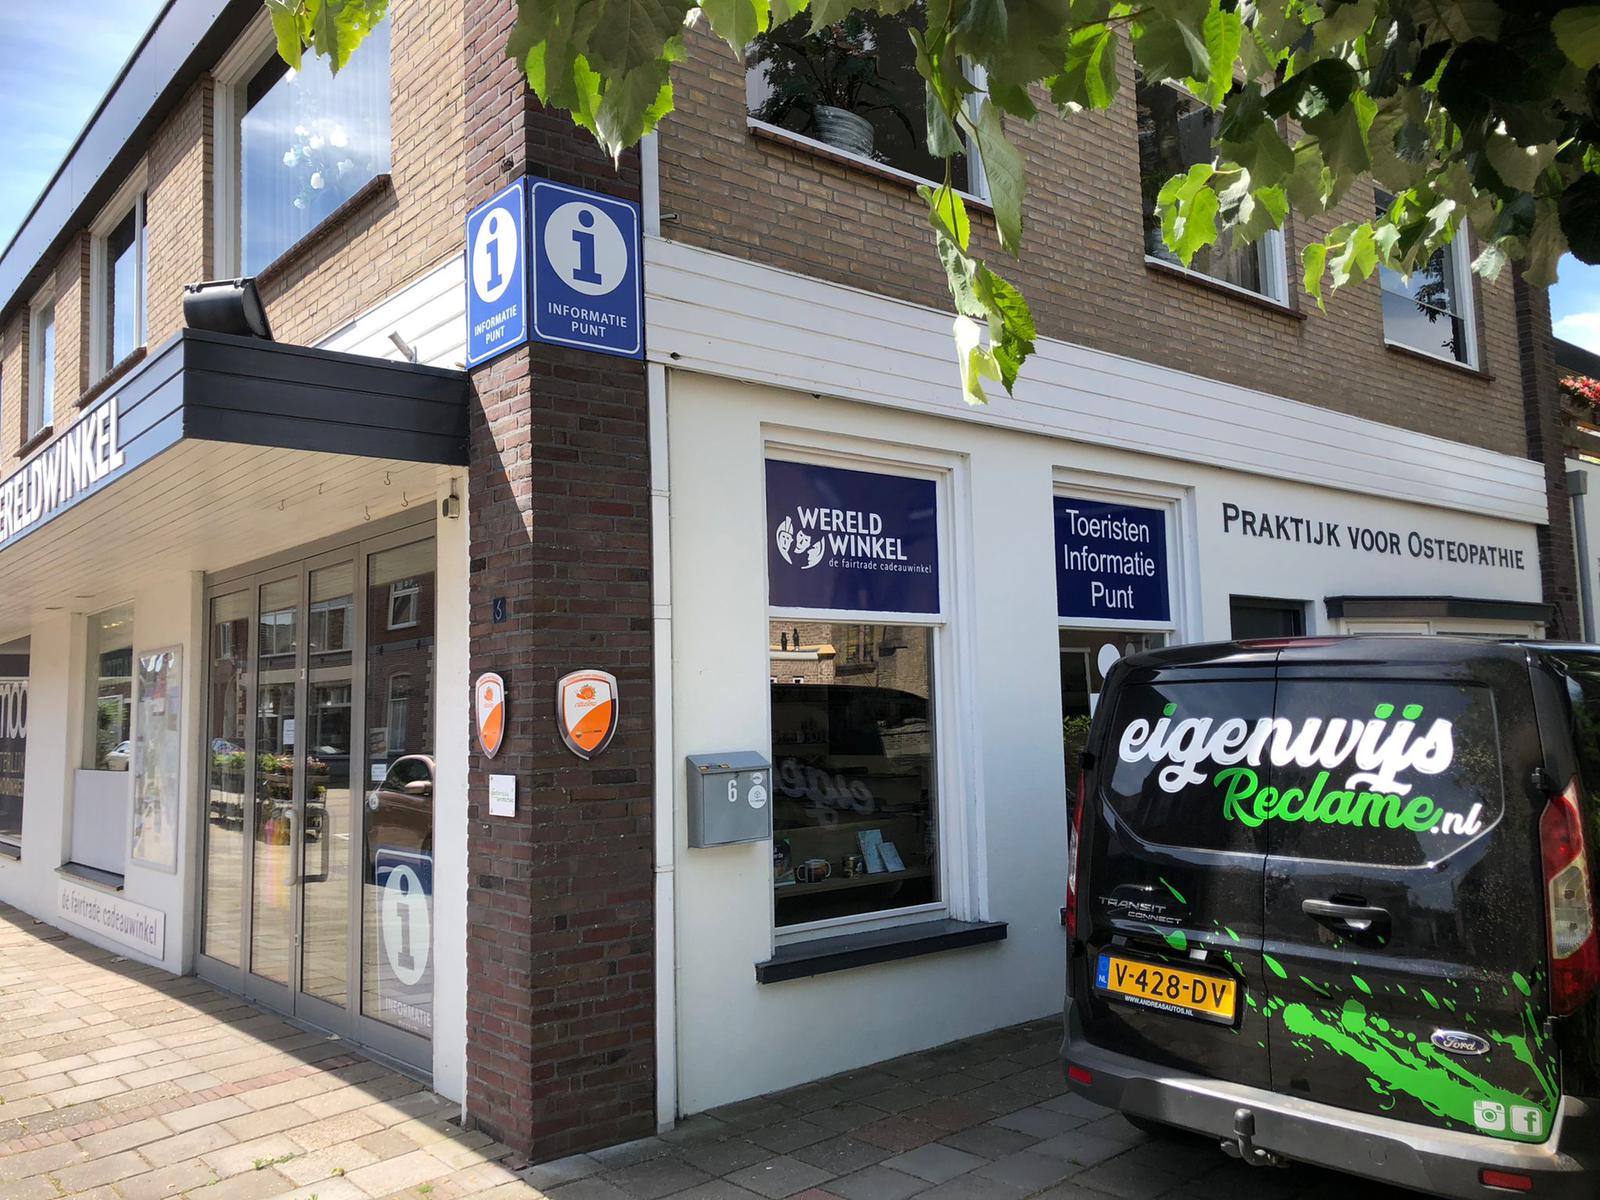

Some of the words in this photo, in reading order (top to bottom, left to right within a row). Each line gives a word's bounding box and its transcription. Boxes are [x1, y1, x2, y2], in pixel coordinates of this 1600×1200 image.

[474, 304, 517, 337] INFORMATIE
[548, 302, 627, 328] INFORMATIE
[485, 325, 505, 344] PUNT
[571, 321, 607, 338] PUNT
[797, 505, 883, 535] WERELD
[1065, 509, 1149, 543] Toeristen
[828, 533, 908, 560] WINKEL
[1222, 502, 1340, 548] PRAKTIJK
[1347, 525, 1401, 555] VOOR
[1408, 531, 1525, 571] OSTEOPATHIE
[828, 558, 839, 567] de
[841, 559, 877, 570] fairtrade
[880, 561, 932, 574] cadeauwinkel
[1063, 544, 1155, 577] Informatie
[1091, 581, 1135, 609] Punt
[1118, 702, 1455, 796] eigenwijs
[727, 779, 738, 802] 6
[62, 888, 70, 910] de
[71, 890, 101, 923] fairtrade
[103, 904, 158, 945] cadeauwinkel
[1099, 896, 1166, 914] TRANSIT
[1128, 911, 1182, 925] CONNECT
[1098, 974, 1107, 984] NL
[1115, 962, 1227, 1009] V-428-DV
[1124, 995, 1194, 1017] WWW.ANDREASAUTOS.NL
[1442, 1034, 1477, 1051] Ford
